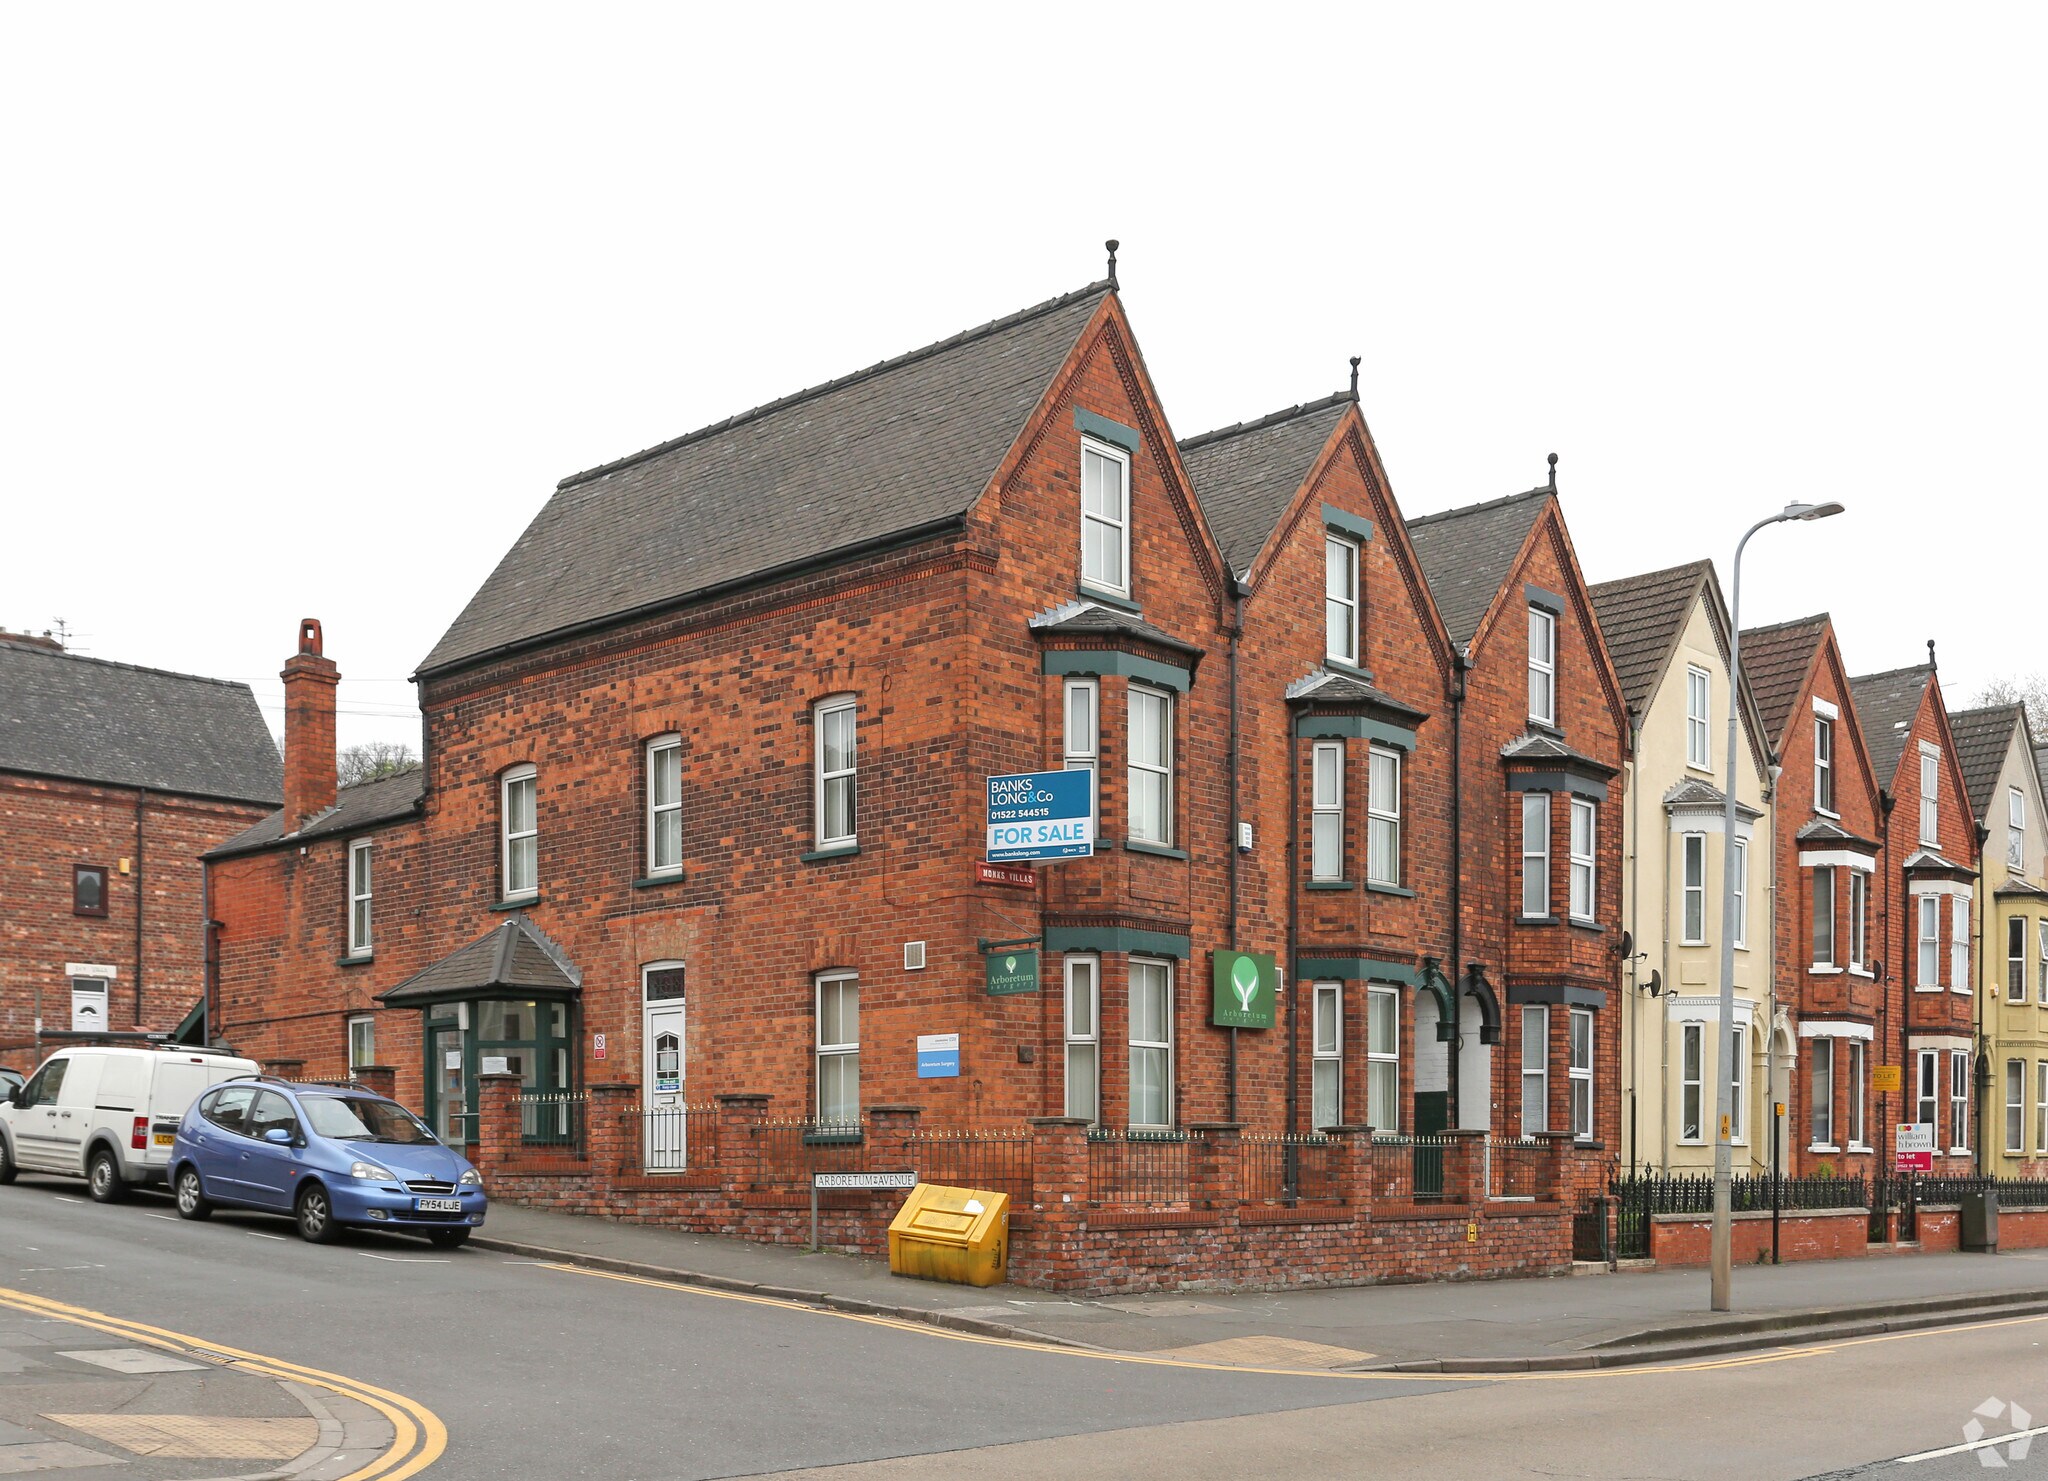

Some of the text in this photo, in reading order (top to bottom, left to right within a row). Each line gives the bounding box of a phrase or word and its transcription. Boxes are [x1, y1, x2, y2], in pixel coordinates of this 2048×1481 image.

[991, 778, 1033, 793] BANKS
[991, 807, 1049, 819] 01522 544515
[993, 823, 1084, 845] FOR SALE
[983, 869, 1033, 884] MONKS VILLAS
[990, 974, 1034, 985] Arboretum
[1223, 1009, 1267, 1019] Arboretum
[1898, 1132, 1926, 1140] william
[819, 1175, 874, 1186] ARBORETUM
[878, 1175, 912, 1186] AVENUE
[420, 1200, 460, 1210] FY54 LJE
